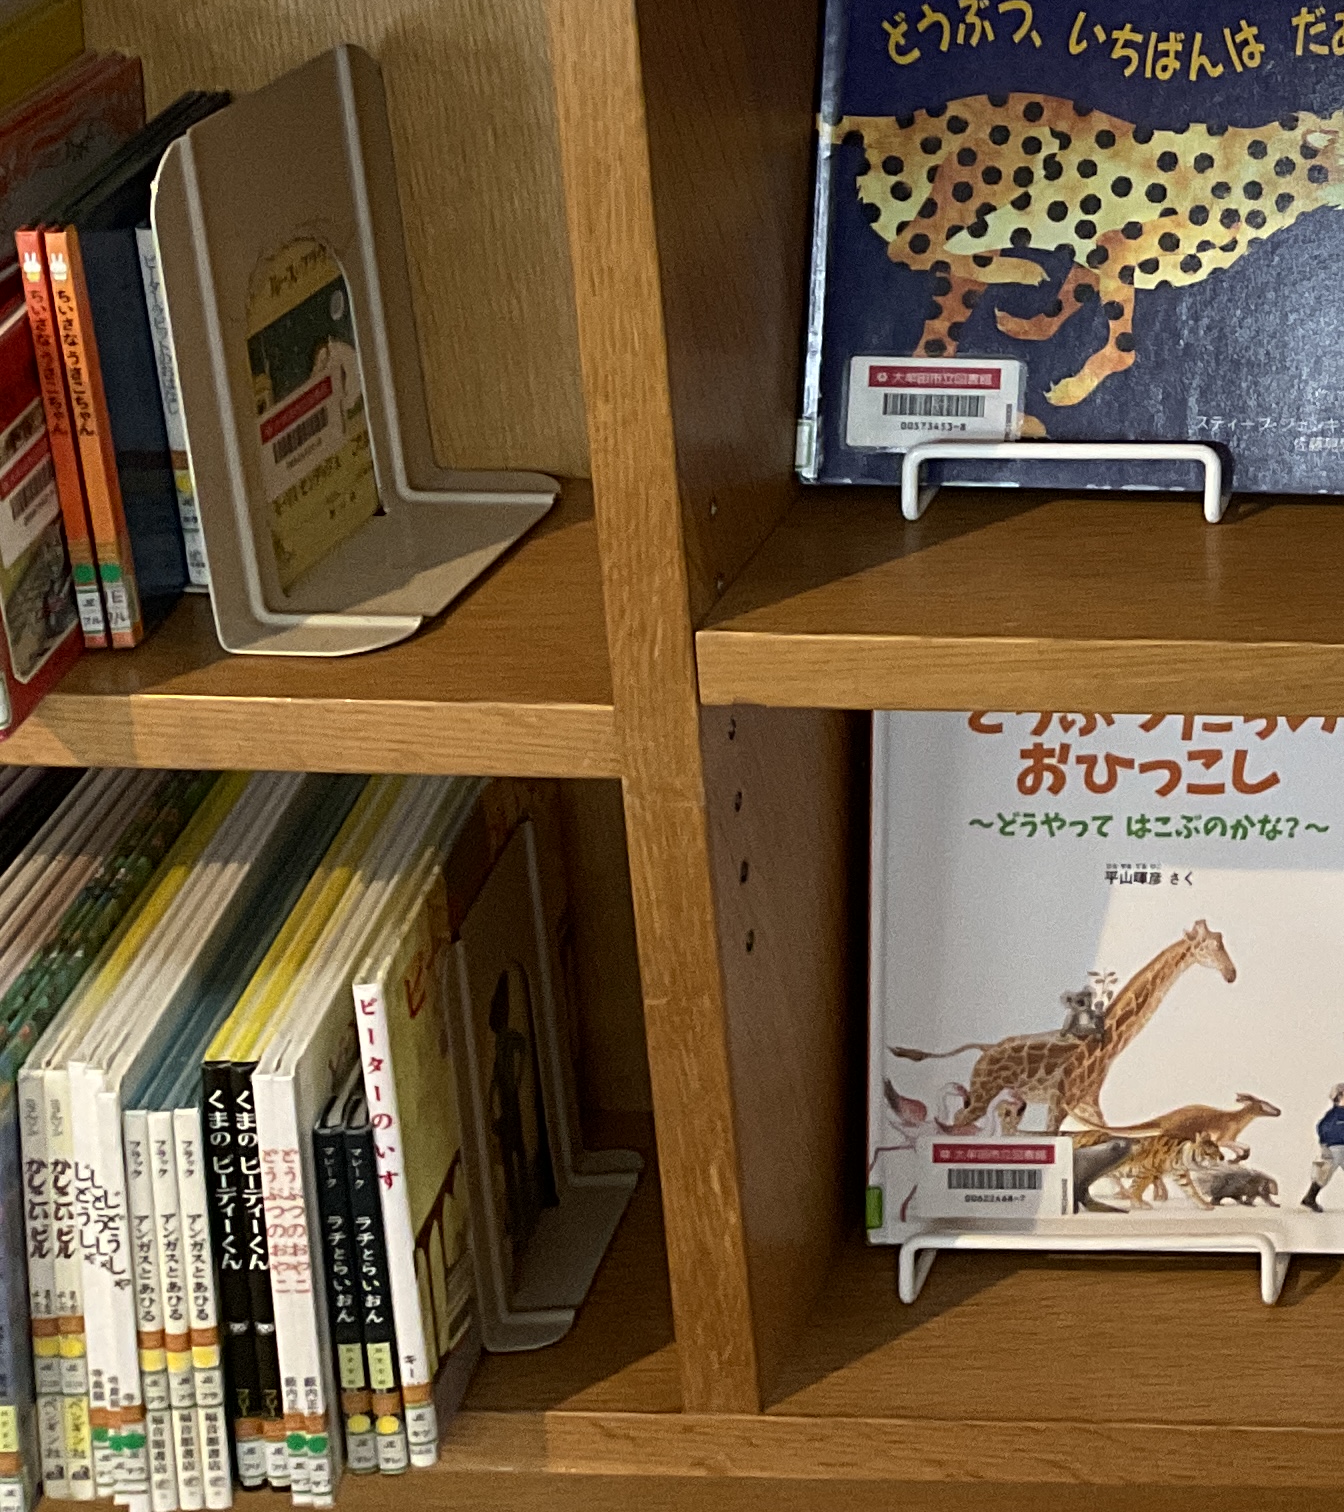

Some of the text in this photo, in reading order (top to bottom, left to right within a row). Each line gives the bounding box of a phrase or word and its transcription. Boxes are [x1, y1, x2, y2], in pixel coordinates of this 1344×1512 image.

[1068, 11, 1266, 82] いちばんは
[56, 289, 97, 439] ちいさなうさこちゃん
[1014, 742, 1282, 798] おひっこし
[967, 812, 1330, 841] 〜どうやって はこぶのかな?〜
[1170, 871, 1193, 886] さく
[205, 1088, 232, 1148] くまの
[233, 1088, 259, 1148] くまの
[358, 996, 400, 1190] ピーターのいす
[25, 1159, 51, 1260] かしこいビル
[50, 1158, 76, 1260] かしこいビル
[94, 1190, 131, 1291] じどうしゃ
[259, 1148, 293, 1295] どうぶつのおやこ
[279, 1148, 313, 1295] どうぶつのおやこ
[134, 1214, 156, 1323] アンガスとあひる
[161, 1213, 183, 1321] アンガスとあひる
[187, 1213, 209, 1321] アンガスとあひる
[325, 1213, 356, 1326] ラチとらいおん
[353, 1215, 384, 1326] ラチとらいおん
